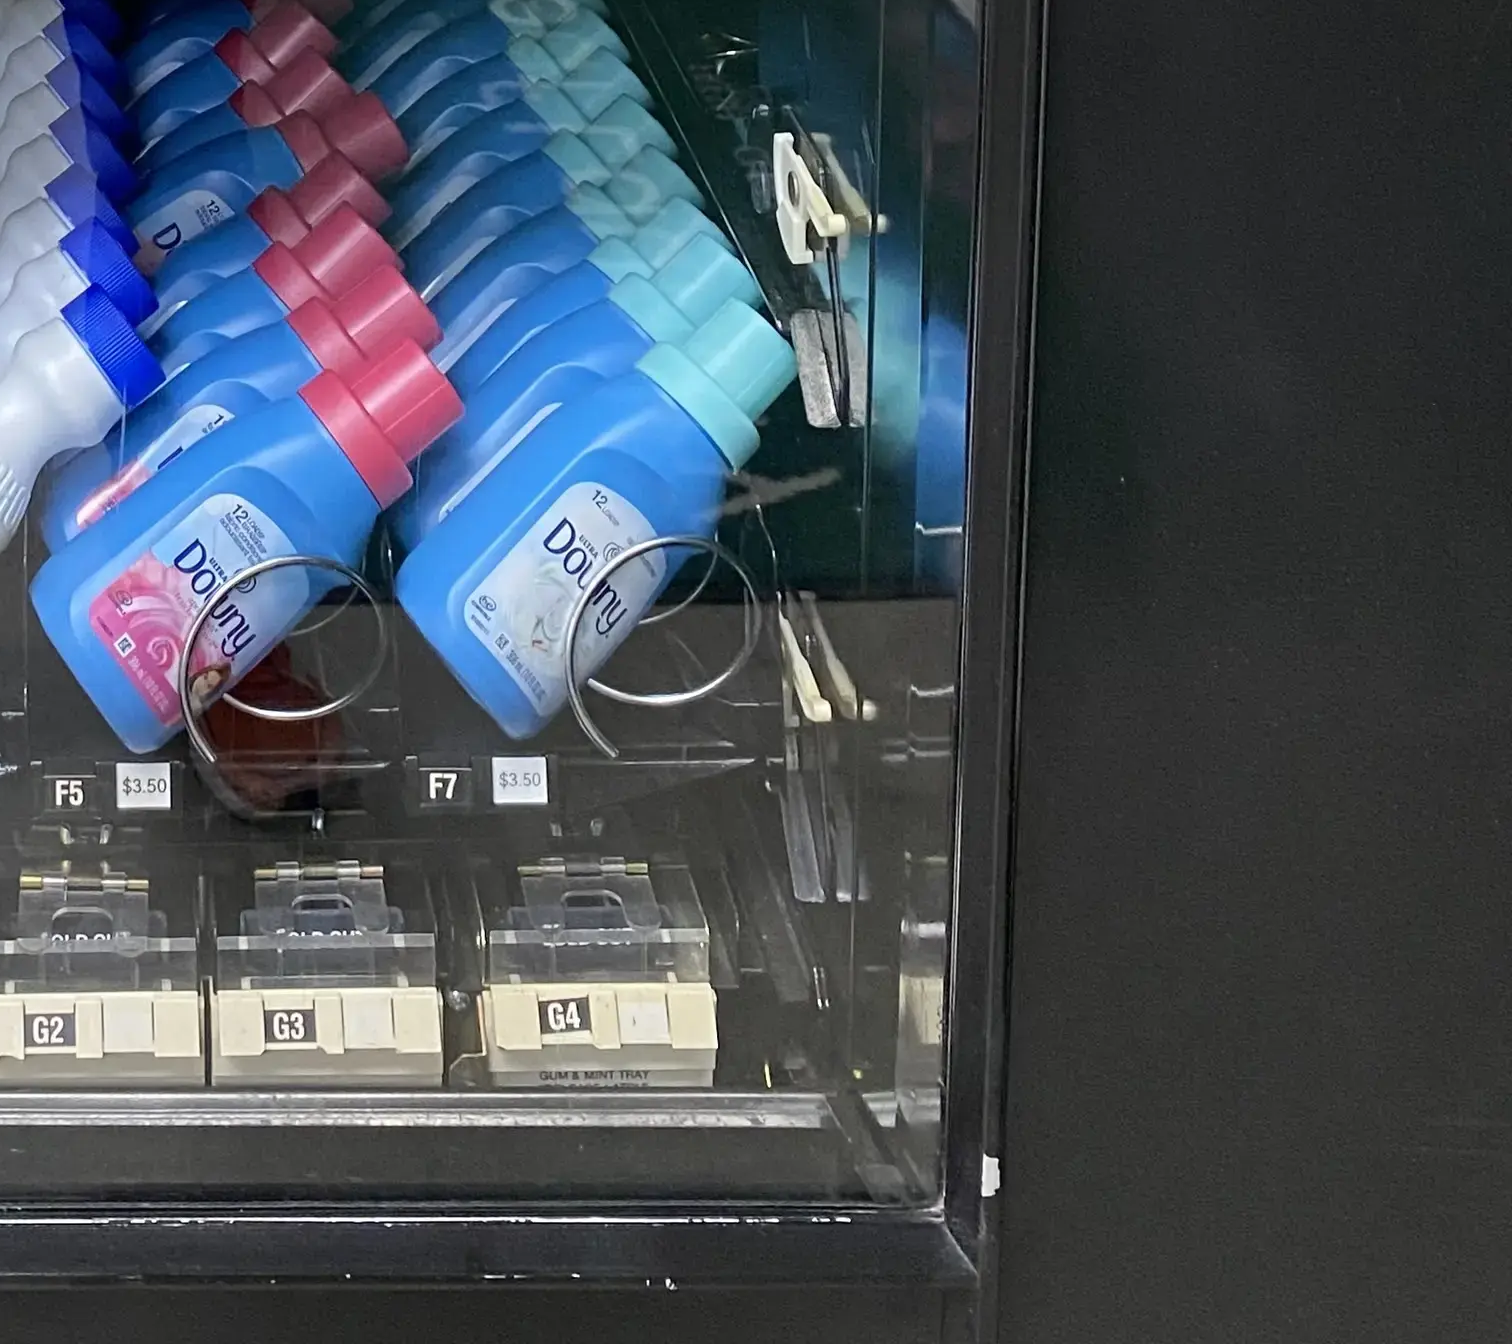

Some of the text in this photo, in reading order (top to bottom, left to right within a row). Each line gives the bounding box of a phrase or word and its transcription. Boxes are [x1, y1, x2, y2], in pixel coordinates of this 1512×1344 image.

[229, 502, 250, 524] 12
[591, 489, 608, 509] 12
[542, 516, 629, 639] Downy
[173, 538, 257, 662] Downy
[55, 779, 85, 807] F5
[121, 777, 168, 795] $3.50
[429, 772, 459, 800] F7
[498, 771, 542, 788] $3.50
[273, 1011, 306, 1041] G3
[547, 1000, 581, 1030] G4
[32, 1014, 65, 1045] G2
[539, 1070, 650, 1081] GUM MINT TRAY
